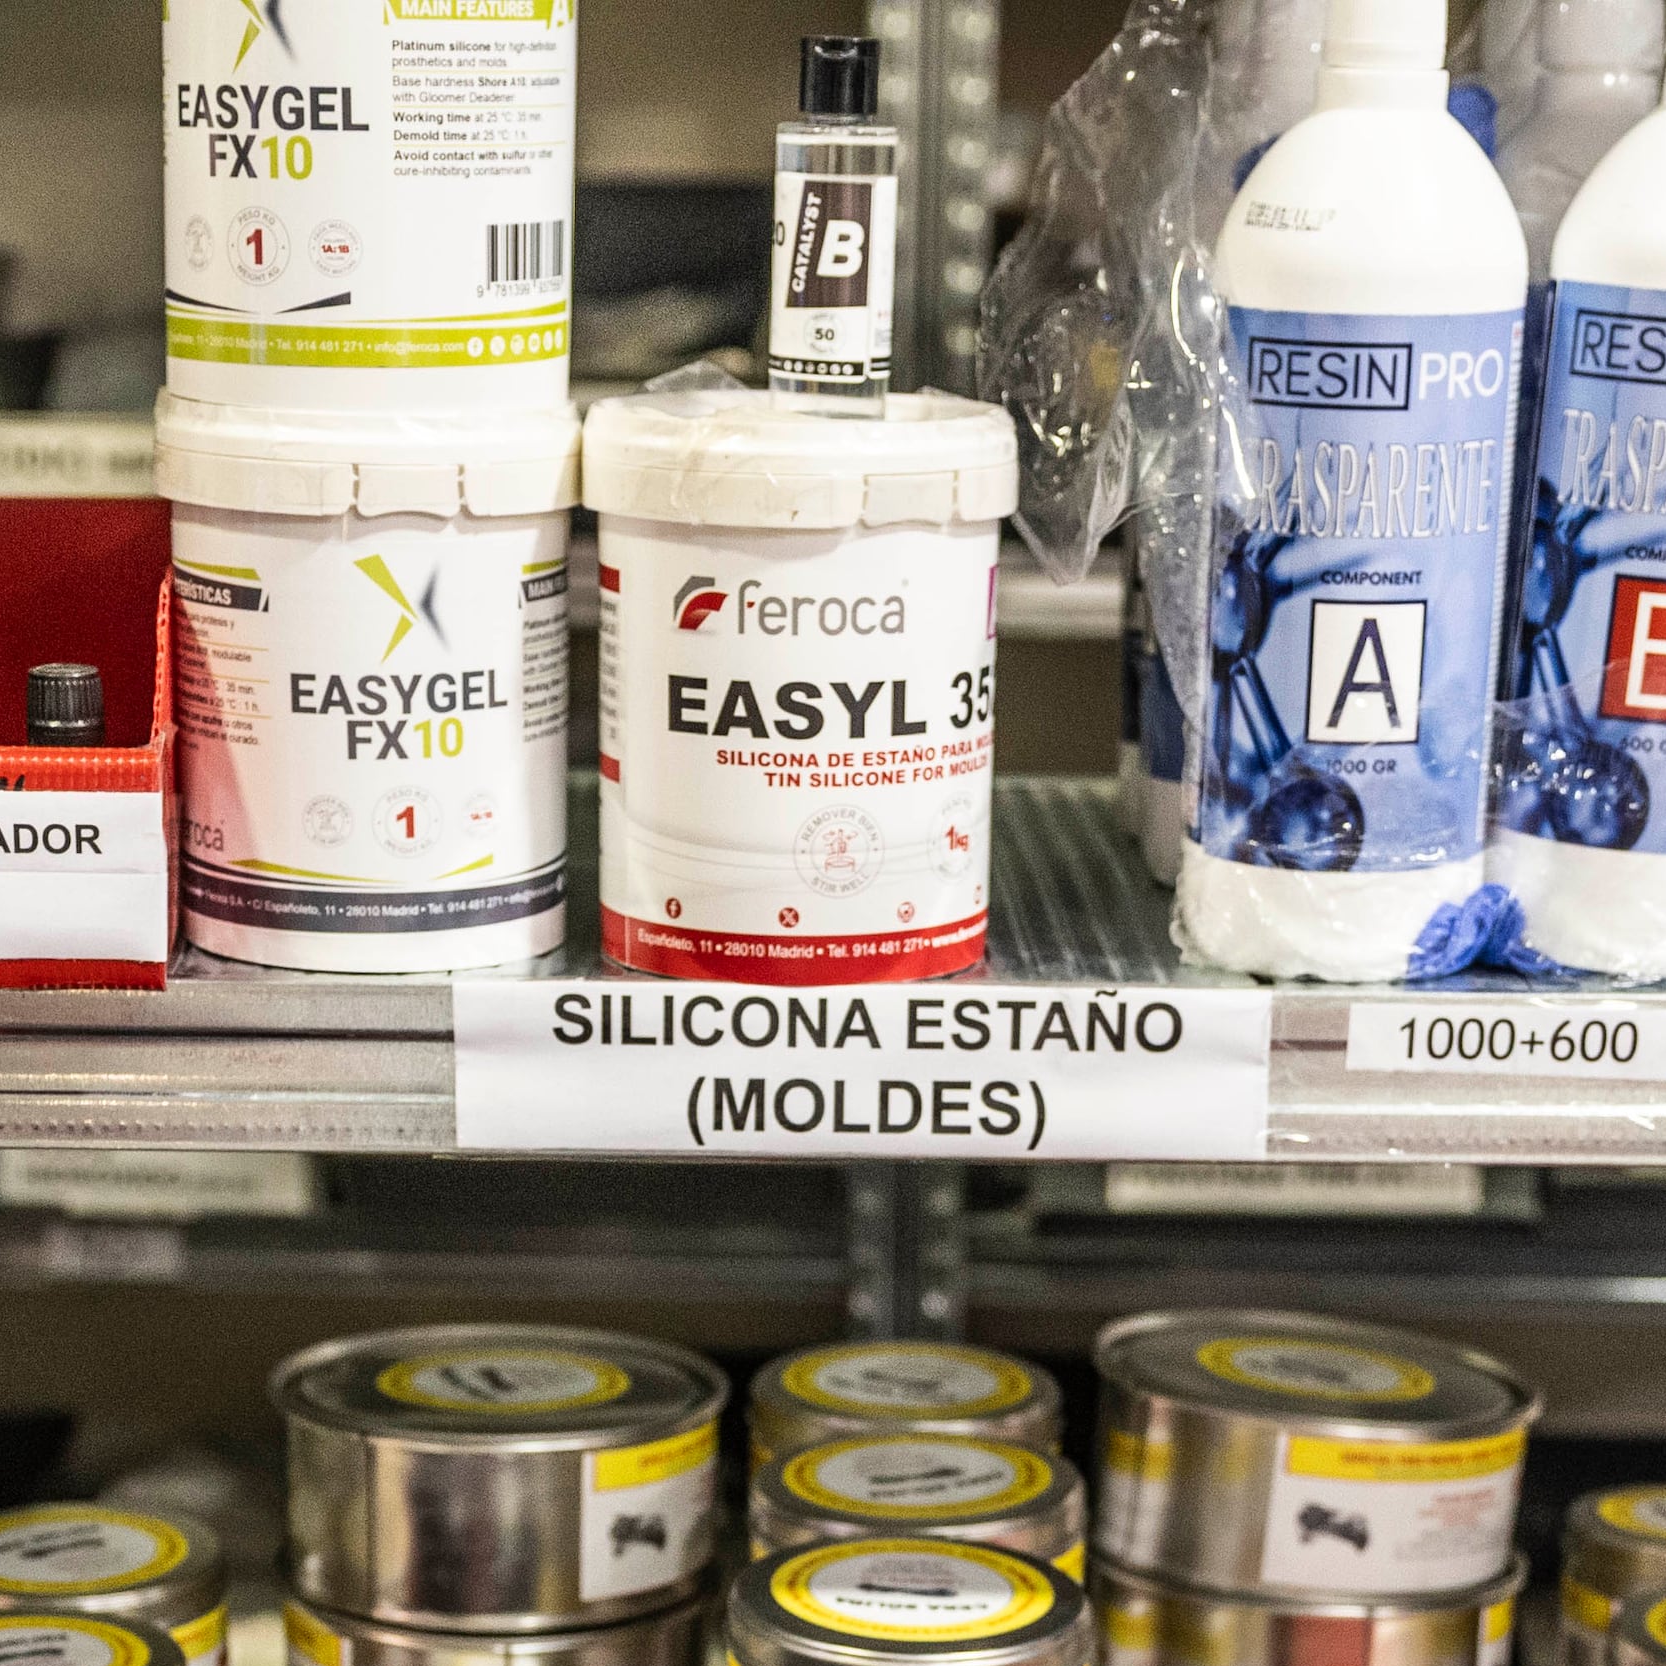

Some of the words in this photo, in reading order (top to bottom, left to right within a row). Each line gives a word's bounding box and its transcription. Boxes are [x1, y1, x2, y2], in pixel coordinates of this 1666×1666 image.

[401, 0, 451, 17] MAIN
[457, 0, 534, 17] FEATURES
[392, 40, 444, 51] Platinum
[449, 42, 490, 52] silicone
[392, 57, 453, 69] prosthetics
[457, 57, 475, 67] and
[393, 76, 421, 86] Base
[426, 76, 474, 86] hardness
[478, 76, 507, 86] Shore
[179, 84, 370, 132] EASYGEL
[393, 93, 415, 103] with
[393, 112, 443, 124] Working
[448, 112, 471, 122] time
[394, 131, 439, 141] Demold
[444, 131, 467, 141] time
[209, 135, 313, 180] FX10
[394, 150, 429, 160] Avoid
[433, 151, 474, 161] contact
[478, 151, 498, 160] with
[246, 229, 264, 265] 1
[792, 191, 823, 294] CATALYST
[816, 219, 865, 278] B
[815, 329, 835, 341] 50
[1255, 347, 1399, 401] RESIN
[1418, 349, 1506, 400] PRO
[1320, 569, 1424, 588] COMPONENT
[737, 578, 906, 638] feroca
[1325, 617, 1403, 730] A
[290, 669, 509, 716] EASYGEL
[667, 674, 928, 740] EASYL
[346, 716, 465, 760] FX10
[716, 749, 820, 769] SILICONA
[827, 751, 855, 768] DE
[863, 744, 936, 768] ESTAÑO
[942, 738, 974, 760] PARA
[764, 771, 802, 788] TIN
[809, 768, 906, 788] SILICONE
[912, 764, 945, 782] FOR
[1371, 759, 1398, 776] GR
[396, 805, 416, 840] 1
[801, 808, 856, 842] REMOVER
[858, 813, 881, 842] BIEN
[811, 876, 837, 895] STIR
[839, 872, 871, 894] WELL
[325, 905, 336, 917] 11
[346, 905, 380, 917] 28010
[383, 904, 419, 917] Madrid
[700, 938, 714, 954] 11
[724, 939, 765, 957] 28010
[768, 943, 815, 959] Madrid
[828, 942, 850, 957] Tel.
[852, 939, 876, 956] 914
[877, 939, 901, 955] 481
[903, 937, 924, 953] 271
[551, 993, 883, 1052] SILICONA
[905, 988, 1186, 1056] ESTAÑO
[1397, 1017, 1640, 1064] 1000+600
[685, 1074, 1046, 1152] (MOLDES)
